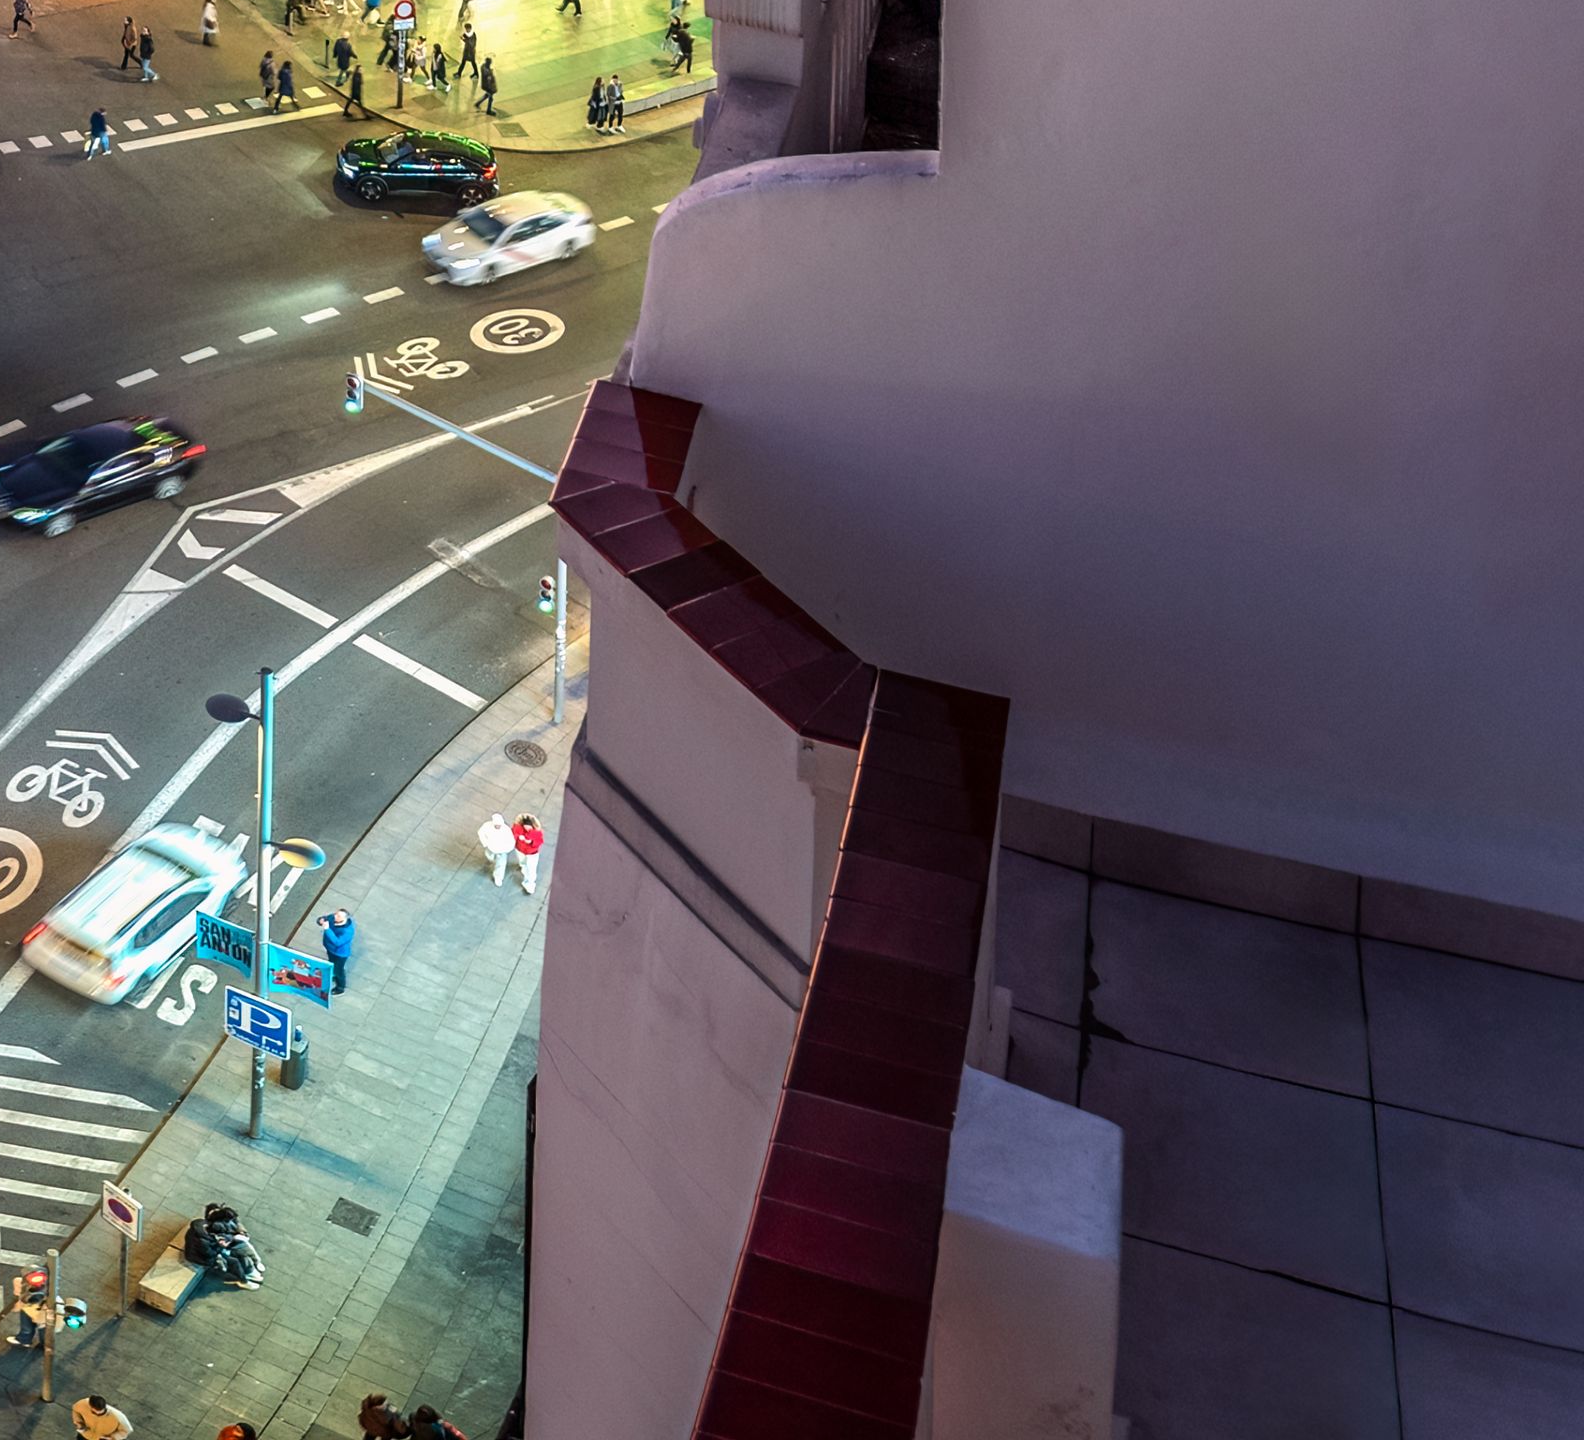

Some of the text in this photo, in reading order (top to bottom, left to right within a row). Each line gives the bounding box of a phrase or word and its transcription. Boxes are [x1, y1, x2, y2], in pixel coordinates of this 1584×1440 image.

[489, 317, 544, 347] 30
[199, 917, 232, 939] SAN
[232, 995, 282, 1038] P
